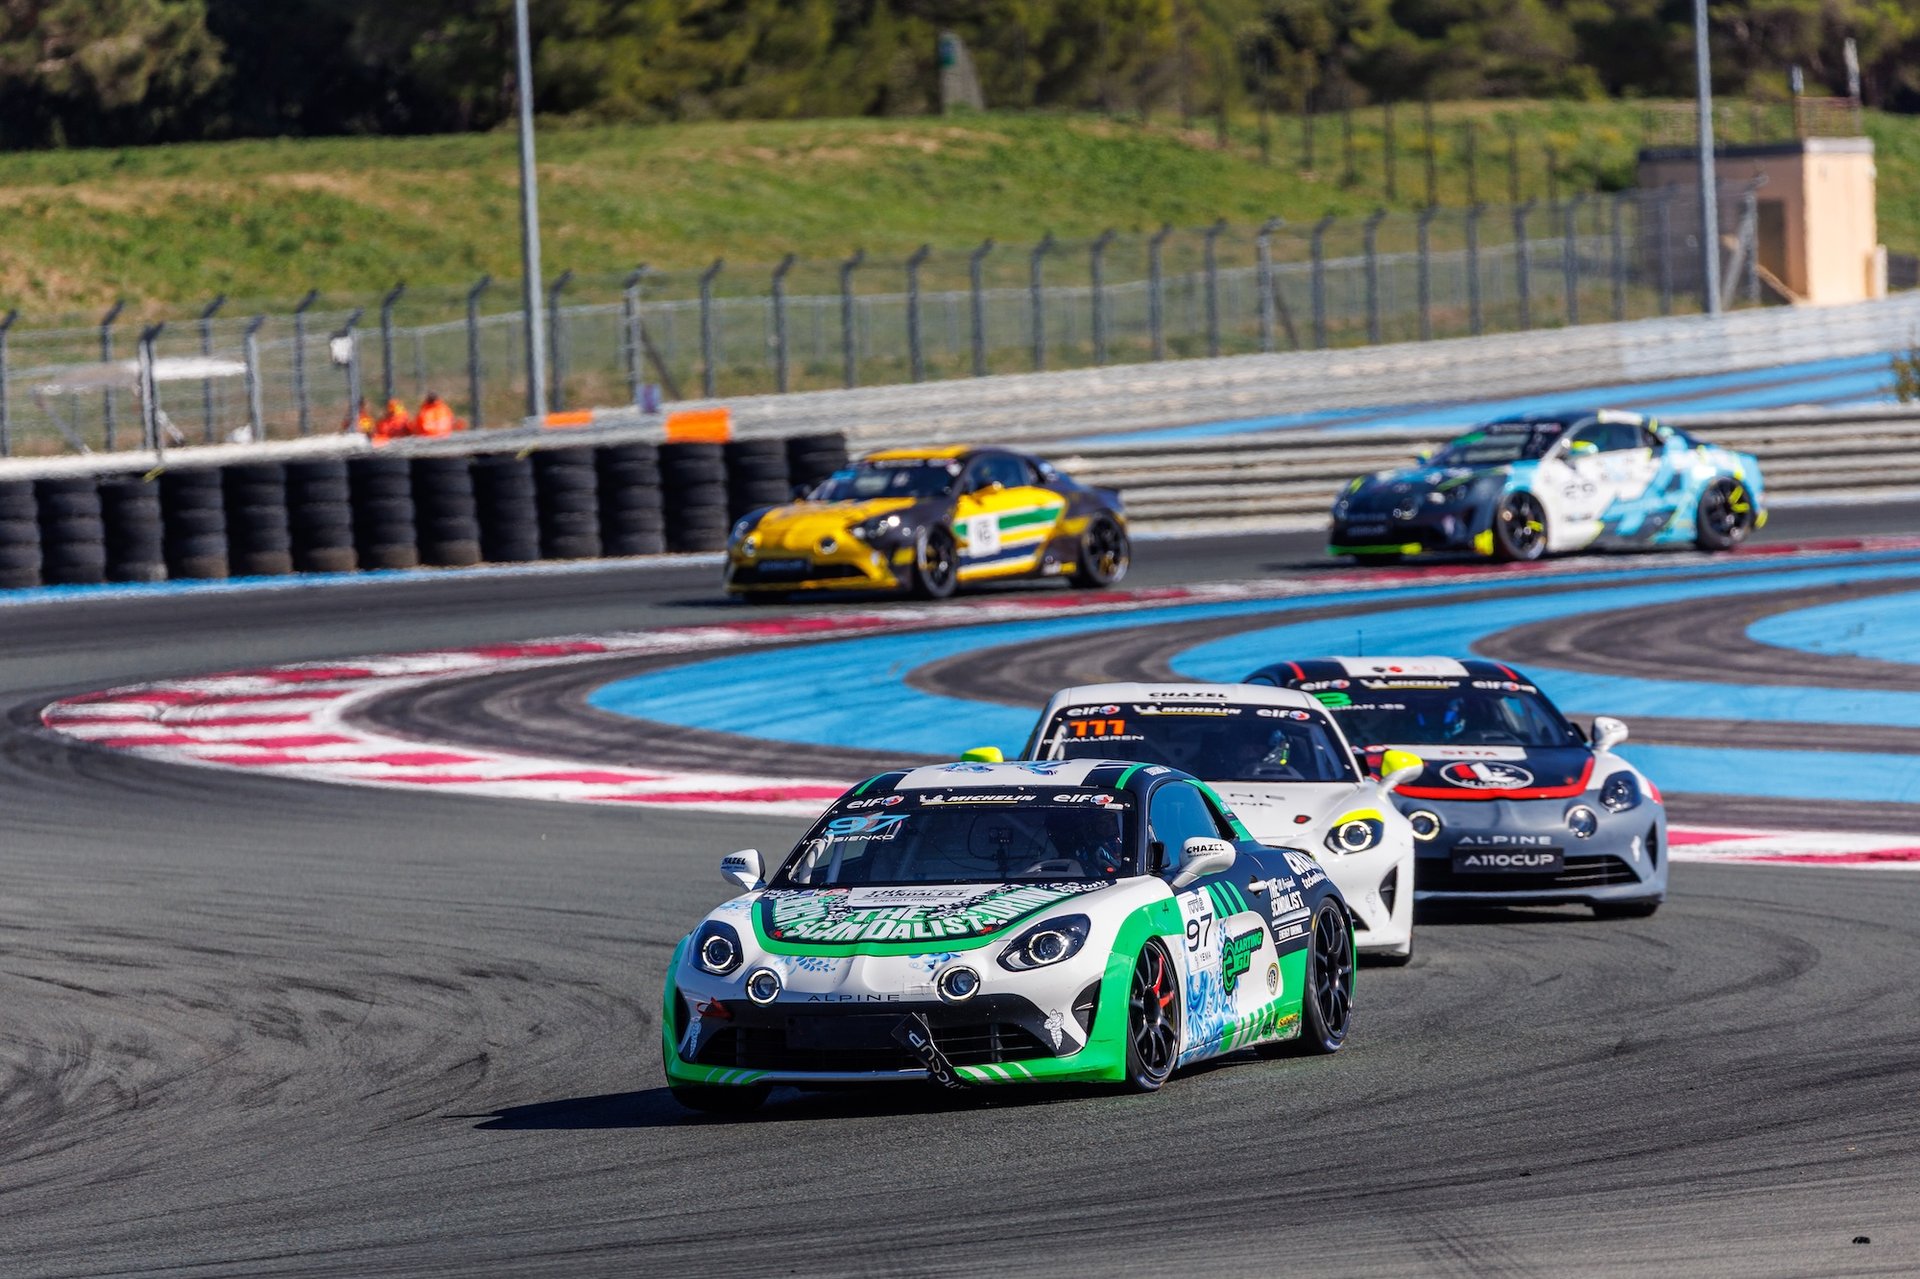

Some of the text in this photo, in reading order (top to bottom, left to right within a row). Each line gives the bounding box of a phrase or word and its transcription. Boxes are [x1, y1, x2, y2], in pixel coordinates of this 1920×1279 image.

[1161, 706, 1242, 714] MICHELIN
[948, 794, 1037, 802] MICHELIN
[828, 814, 911, 835] 97
[1458, 835, 1552, 845] ALPINE
[1186, 843, 1224, 854] CHAZEL
[1464, 853, 1555, 867] A110CUP
[852, 906, 935, 921] THE
[784, 914, 986, 940] SCANDALIST
[1186, 912, 1213, 952] 97
[1235, 931, 1262, 954] KARTING
[807, 994, 900, 1002] ALPINE
